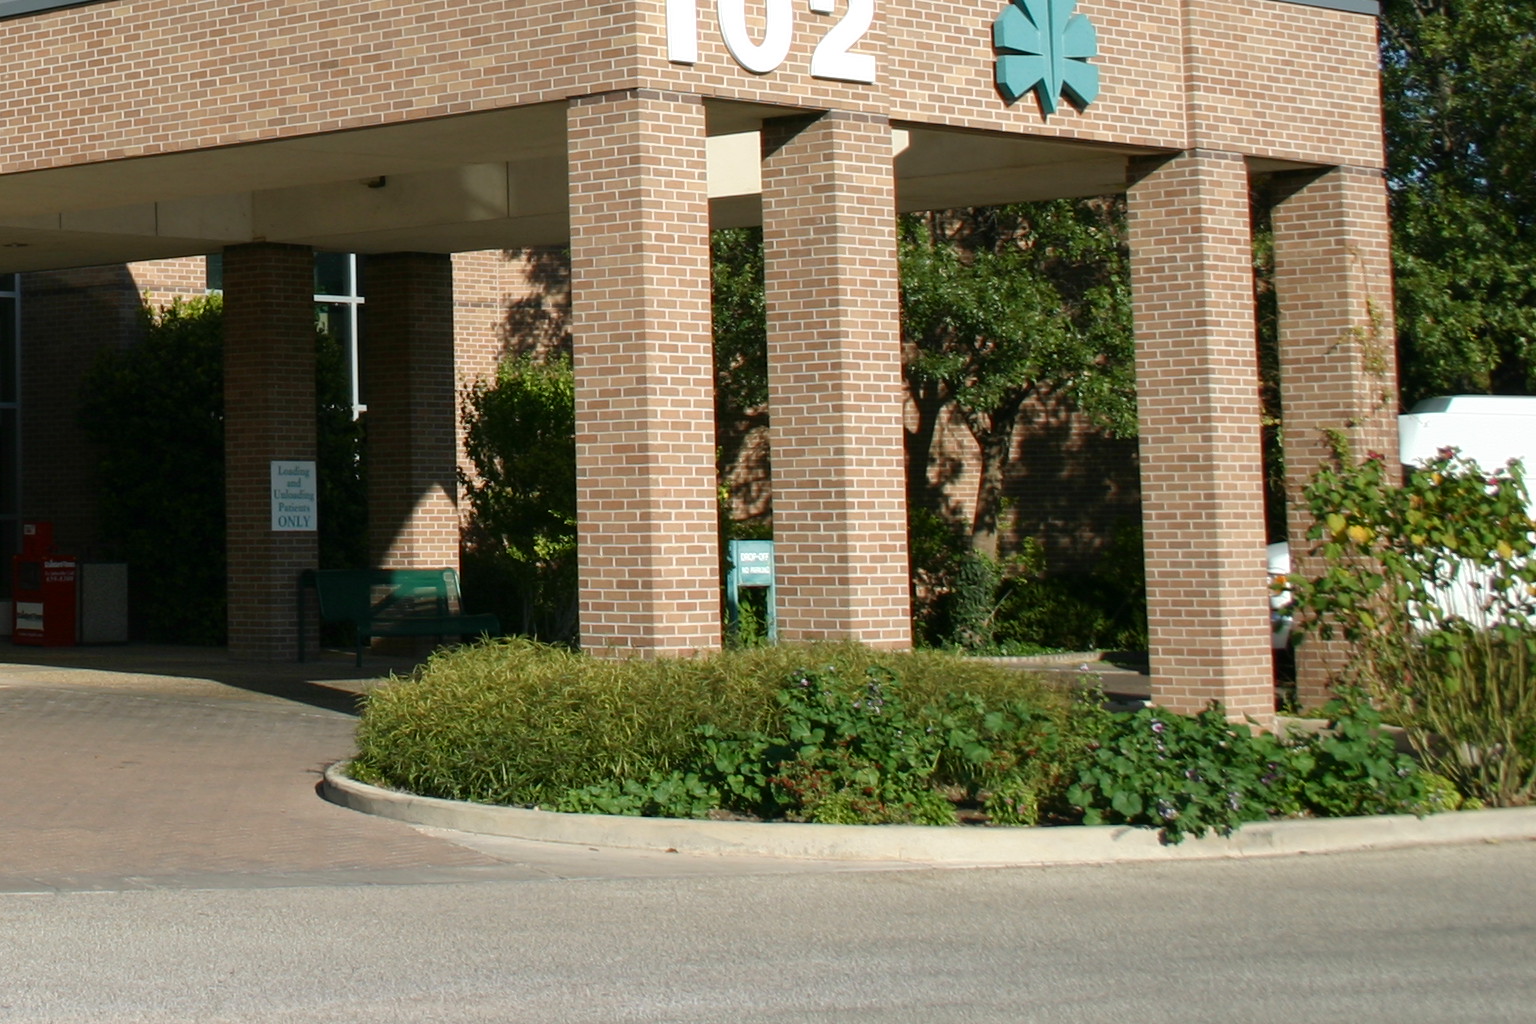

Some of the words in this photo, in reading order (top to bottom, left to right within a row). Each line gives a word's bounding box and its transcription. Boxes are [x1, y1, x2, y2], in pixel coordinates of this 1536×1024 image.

[278, 465, 310, 478] Loading
[287, 477, 302, 488] and
[273, 489, 315, 502] Unloading
[278, 502, 310, 513] Patients
[278, 516, 311, 528] ONLY
[740, 553, 770, 561] DROP-OFF
